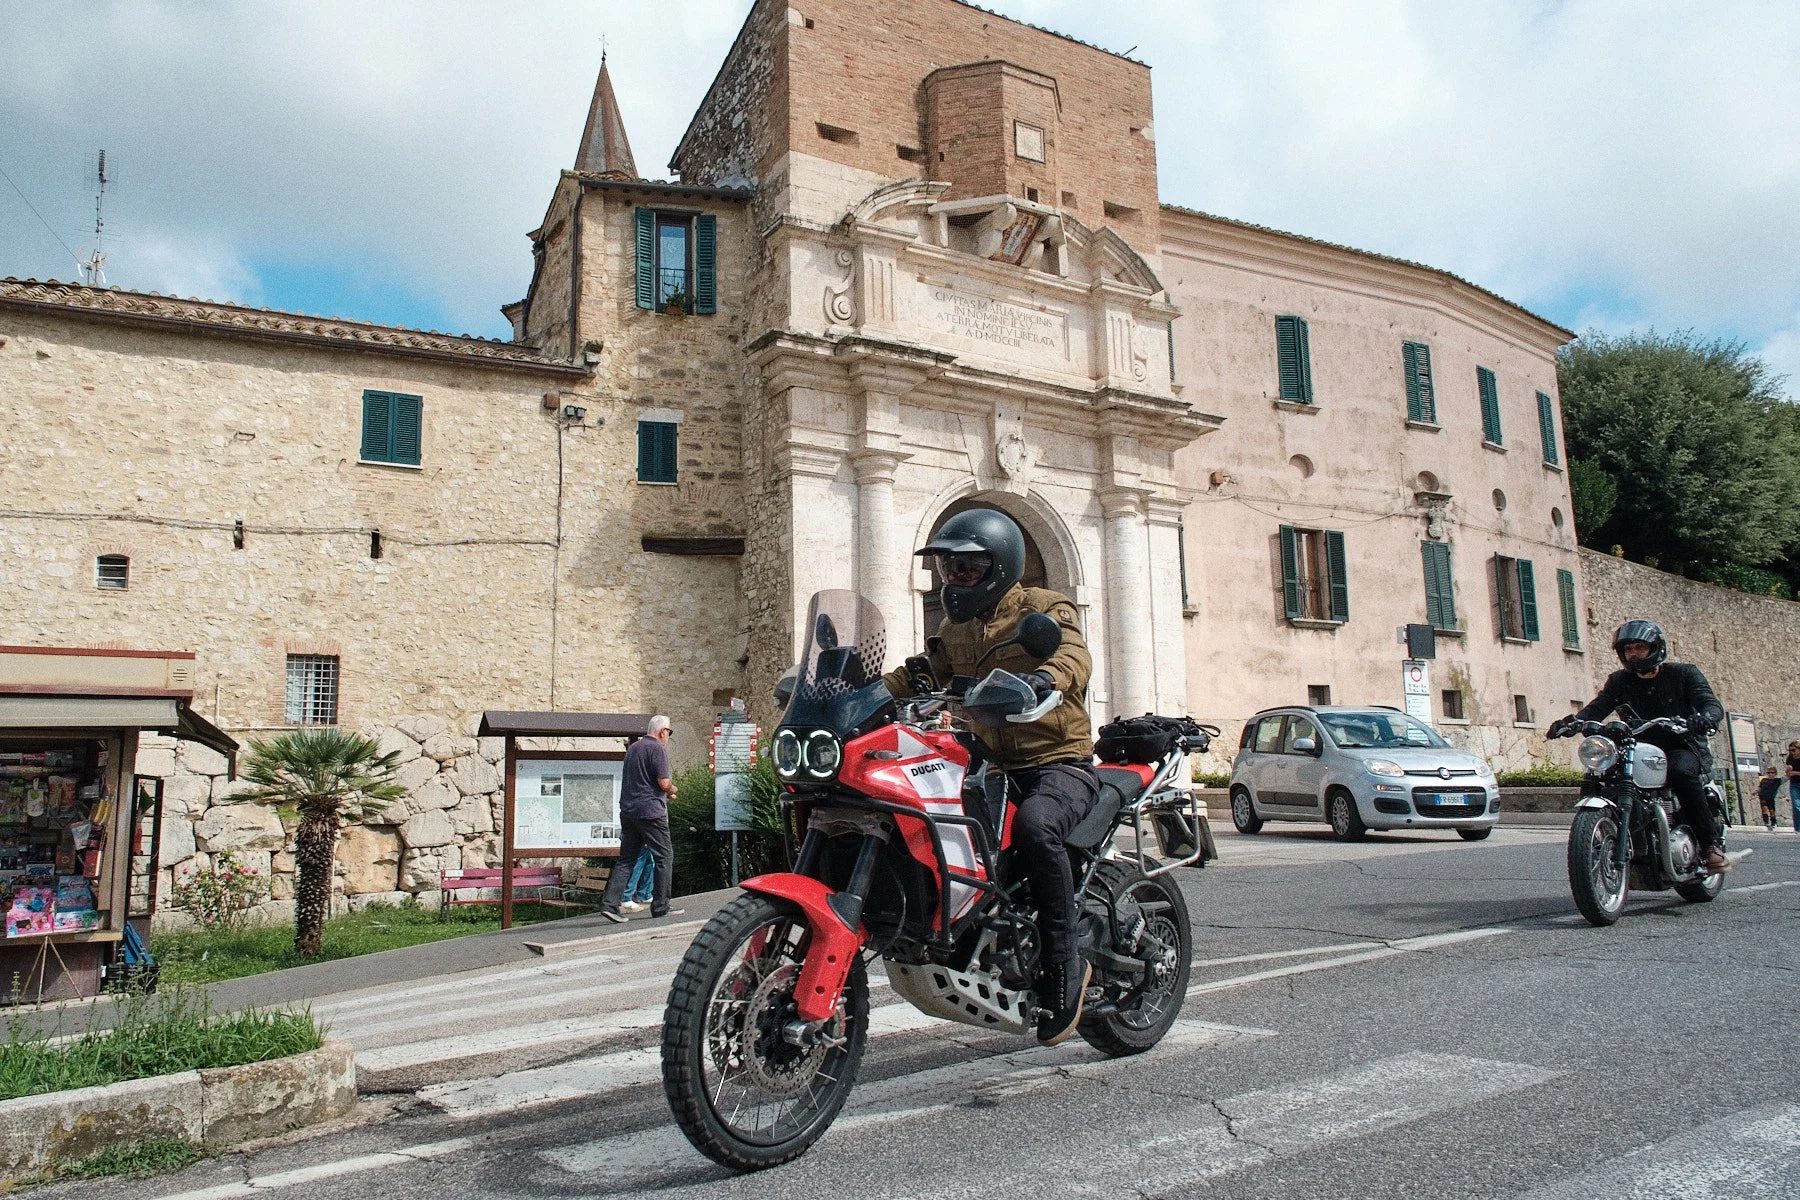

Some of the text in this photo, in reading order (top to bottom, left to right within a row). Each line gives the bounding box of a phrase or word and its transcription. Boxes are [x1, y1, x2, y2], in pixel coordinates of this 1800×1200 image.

[935, 291, 975, 308] CIVITAS
[954, 305, 964, 315] IN
[967, 308, 1008, 326] NOMINE
[1014, 329, 1054, 347] LIBERATA
[911, 763, 946, 776] DUCATI
